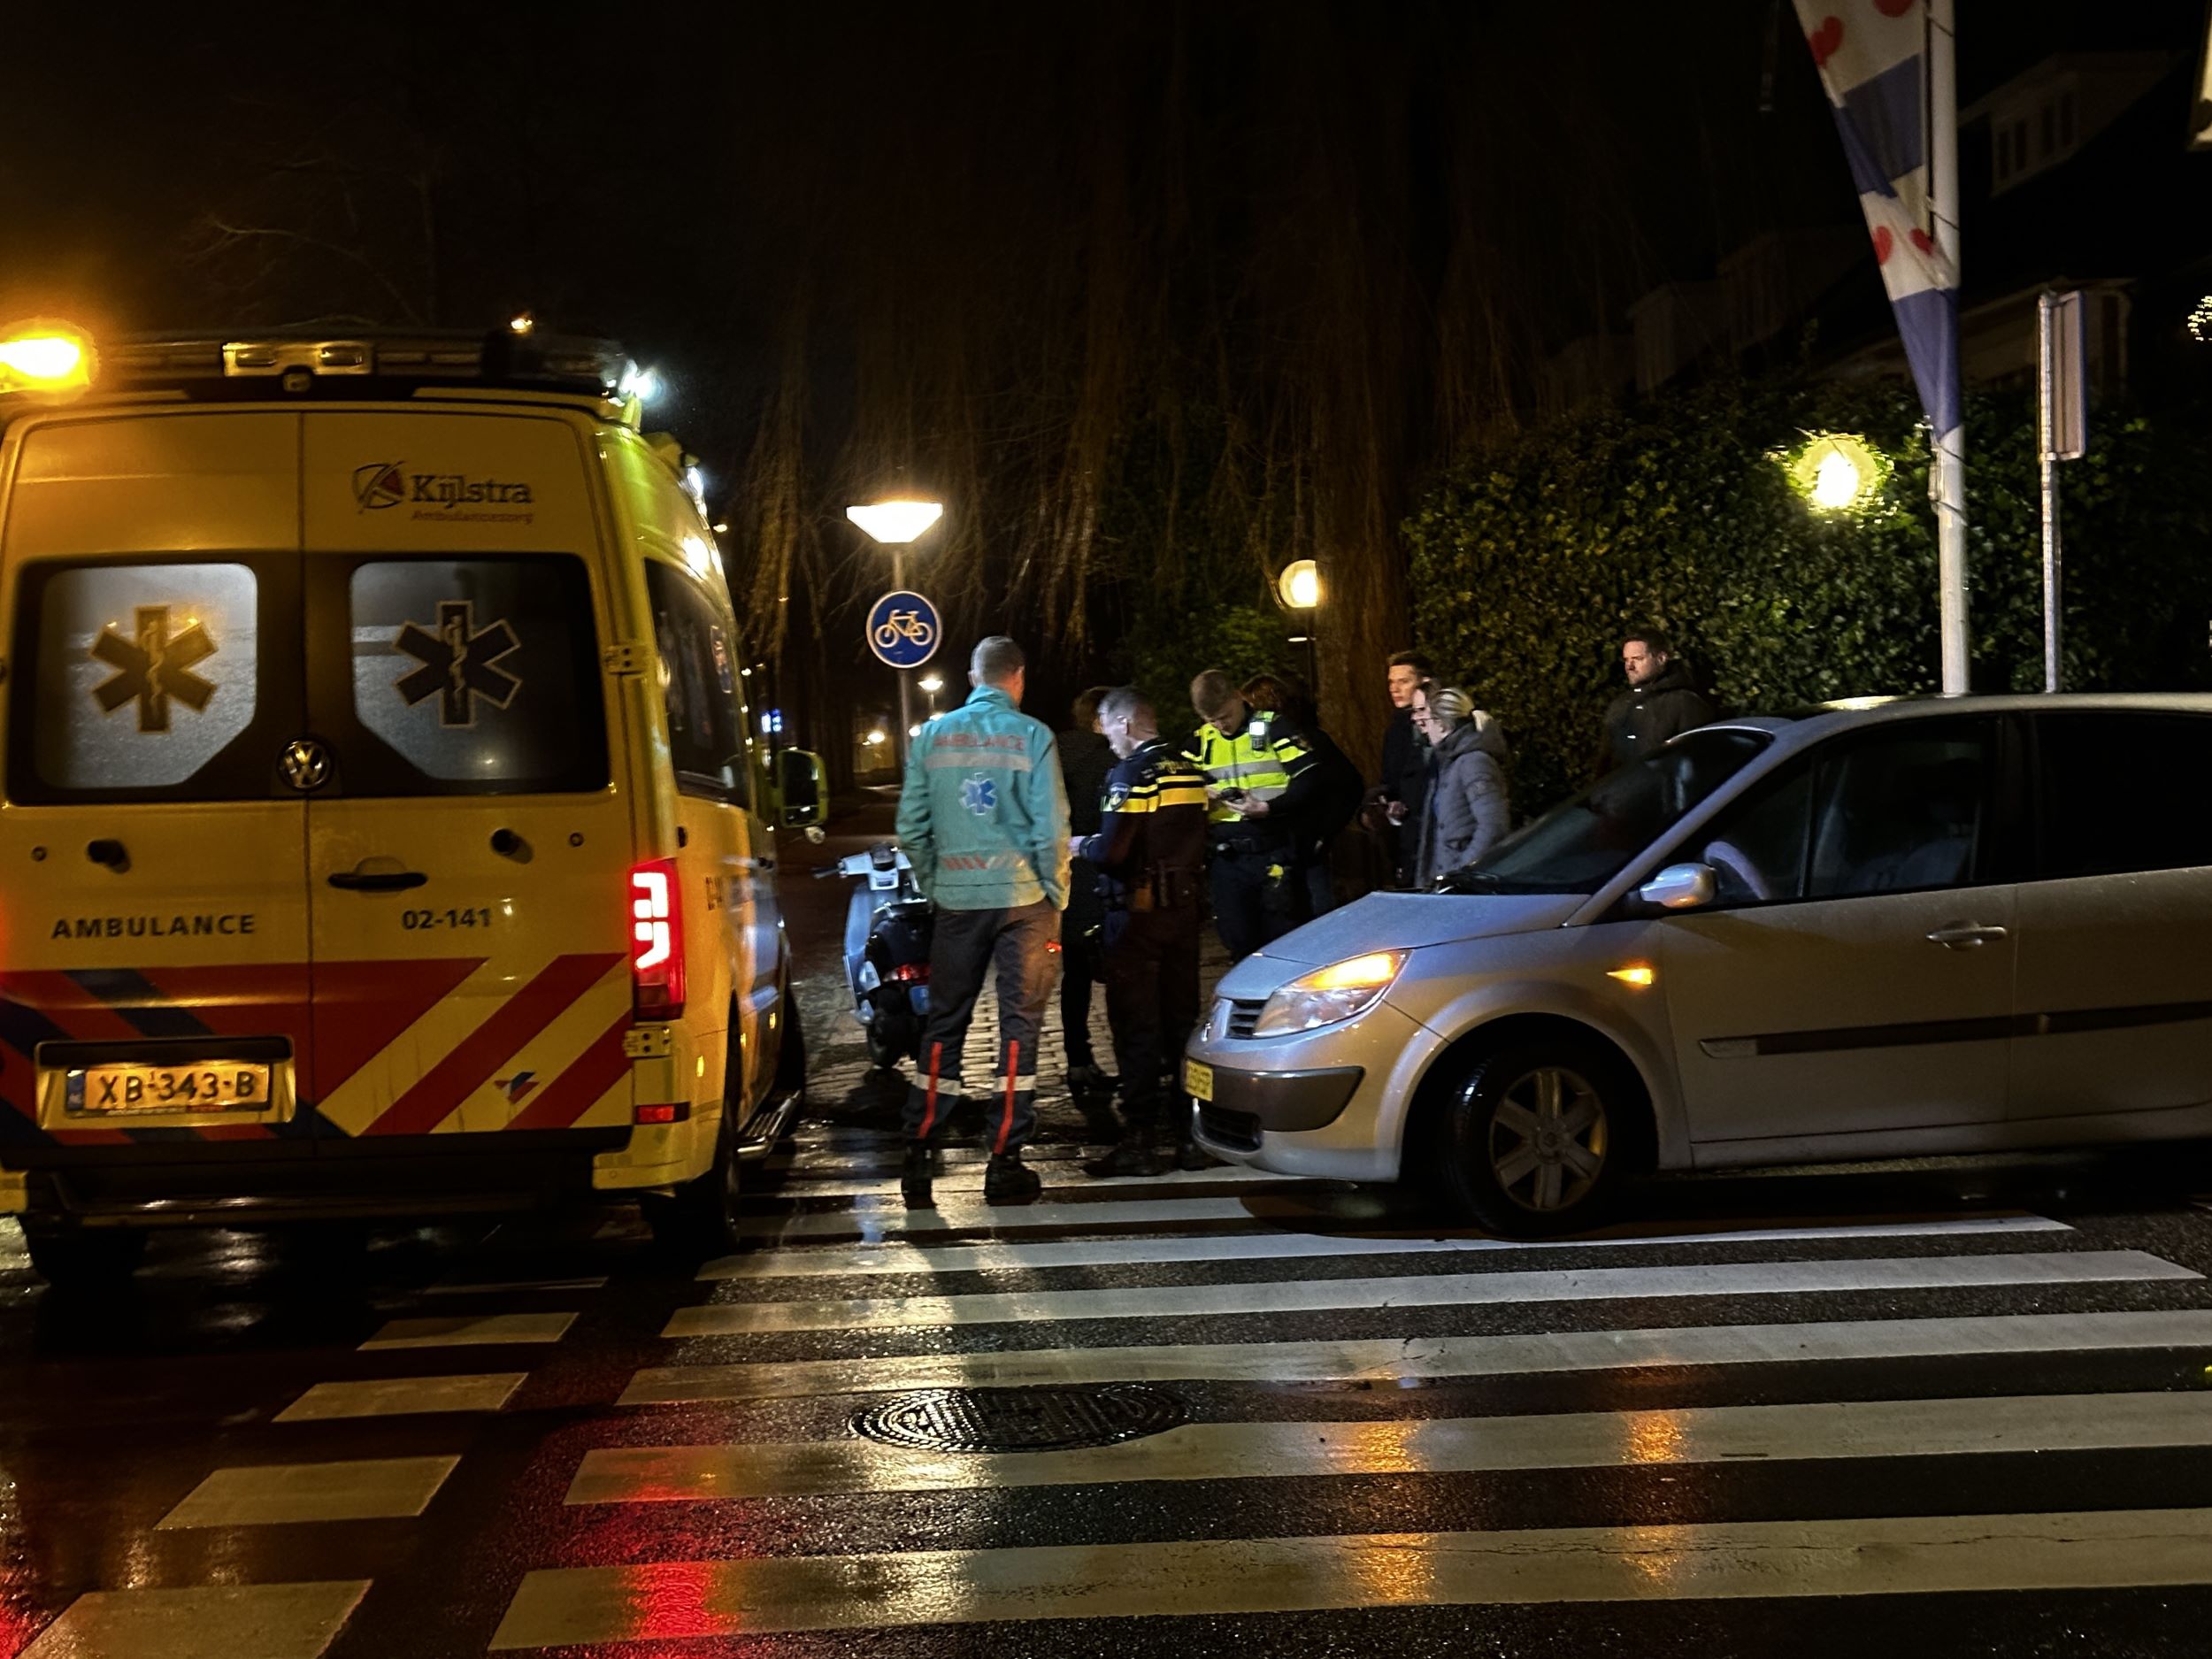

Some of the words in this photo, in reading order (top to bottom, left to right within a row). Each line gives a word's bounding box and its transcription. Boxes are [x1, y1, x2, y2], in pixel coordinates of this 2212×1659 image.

[411, 474, 534, 509] Kijlstra
[50, 914, 255, 940] AMBULANCE
[402, 908, 492, 930] 02-141
